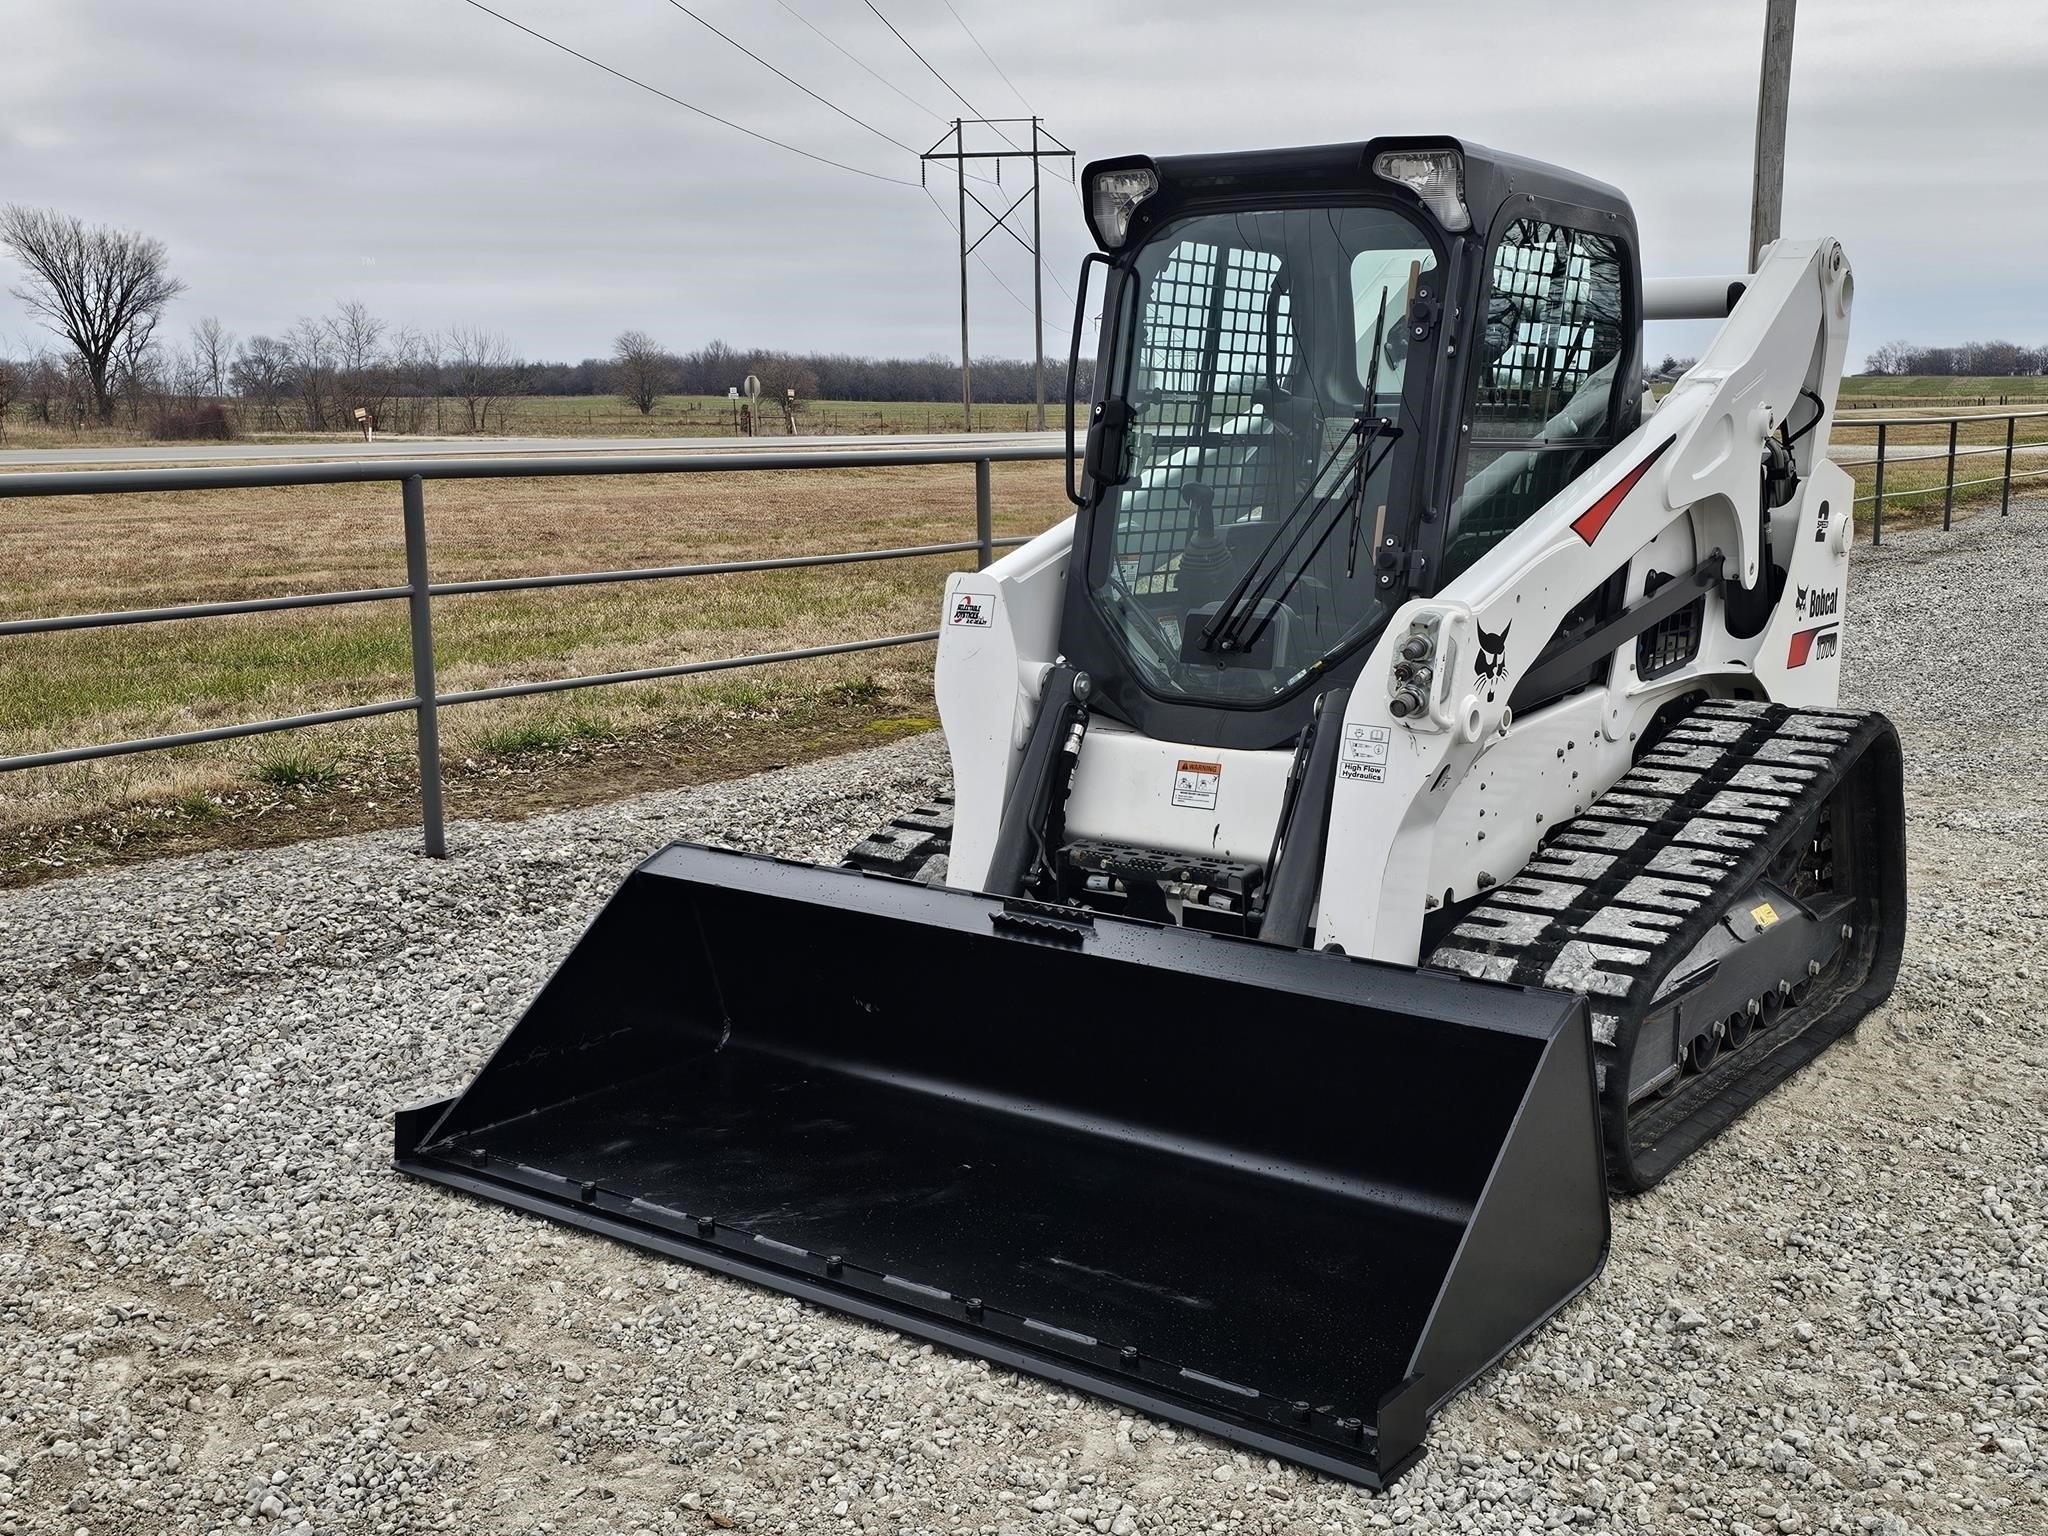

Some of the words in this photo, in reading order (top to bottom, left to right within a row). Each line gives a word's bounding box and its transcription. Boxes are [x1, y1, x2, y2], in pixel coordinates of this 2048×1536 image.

[1815, 500, 1829, 542] 2
[1809, 587, 1838, 618] Bobcat
[1189, 763, 1217, 773] WARNING
[1344, 763, 1362, 772] High
[1363, 765, 1382, 774] Flow
[1342, 770, 1382, 781] Hydraulics
